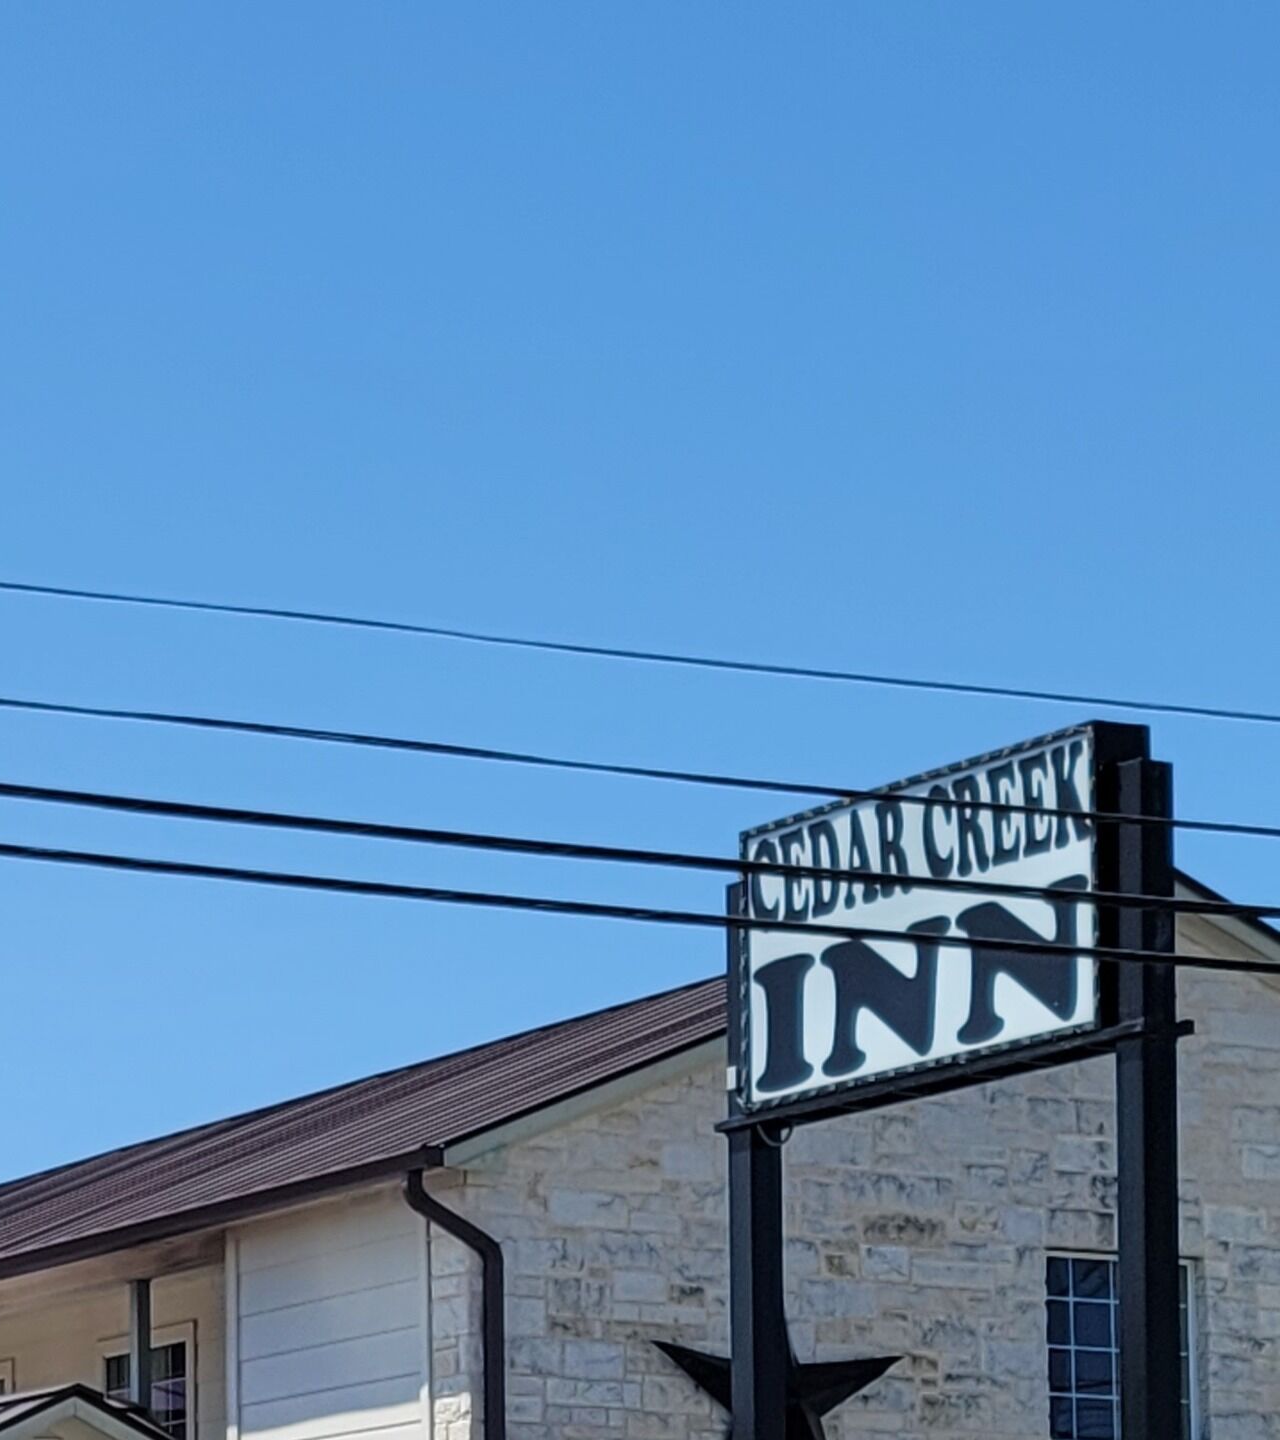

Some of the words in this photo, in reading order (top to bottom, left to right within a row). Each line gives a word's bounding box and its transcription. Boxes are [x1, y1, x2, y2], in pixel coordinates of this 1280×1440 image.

[749, 799, 912, 923] CEDAR
[923, 741, 1092, 879] CREEK
[754, 874, 1090, 1093] INN
